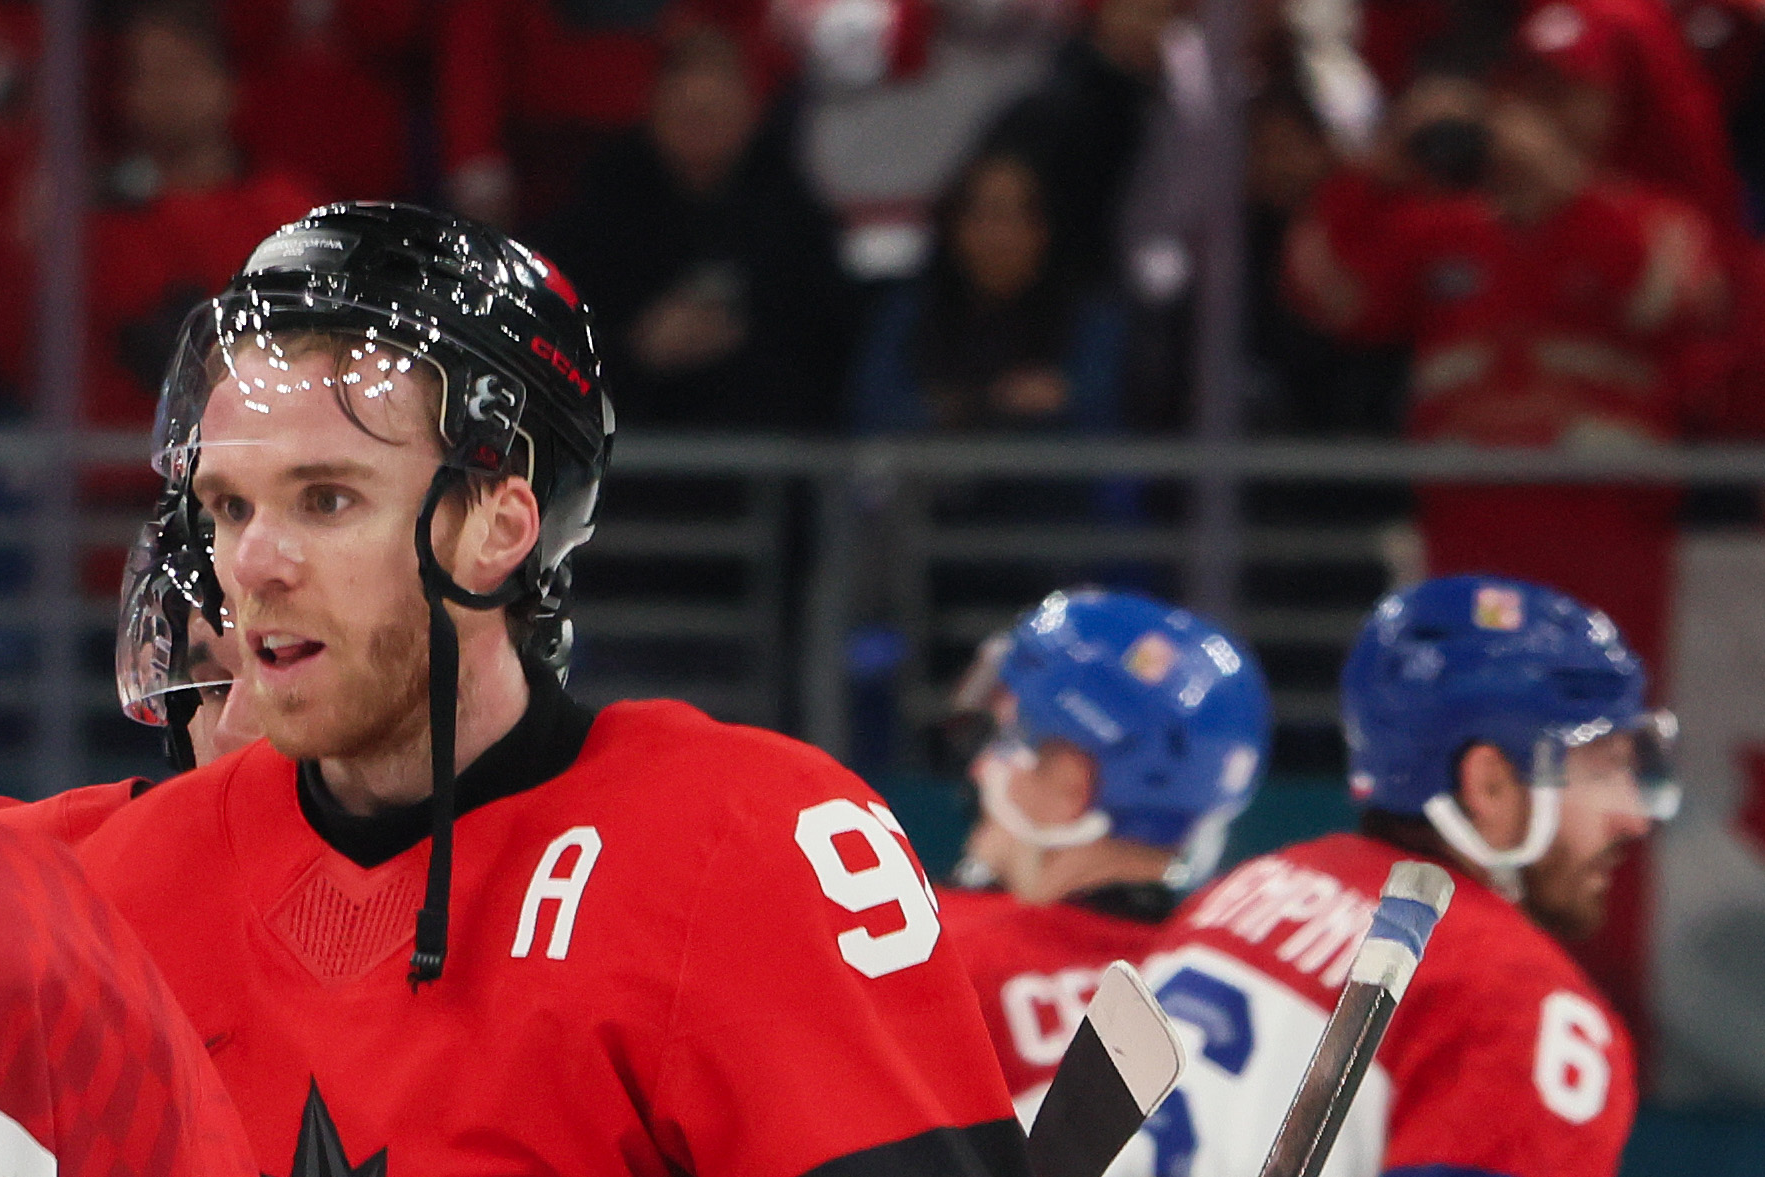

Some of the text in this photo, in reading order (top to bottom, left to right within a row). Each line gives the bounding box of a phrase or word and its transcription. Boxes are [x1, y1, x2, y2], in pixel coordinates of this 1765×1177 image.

[530, 334, 591, 397] CCM
[510, 825, 603, 960] A
[794, 798, 941, 980] 9
[1536, 991, 1614, 1124] 6
